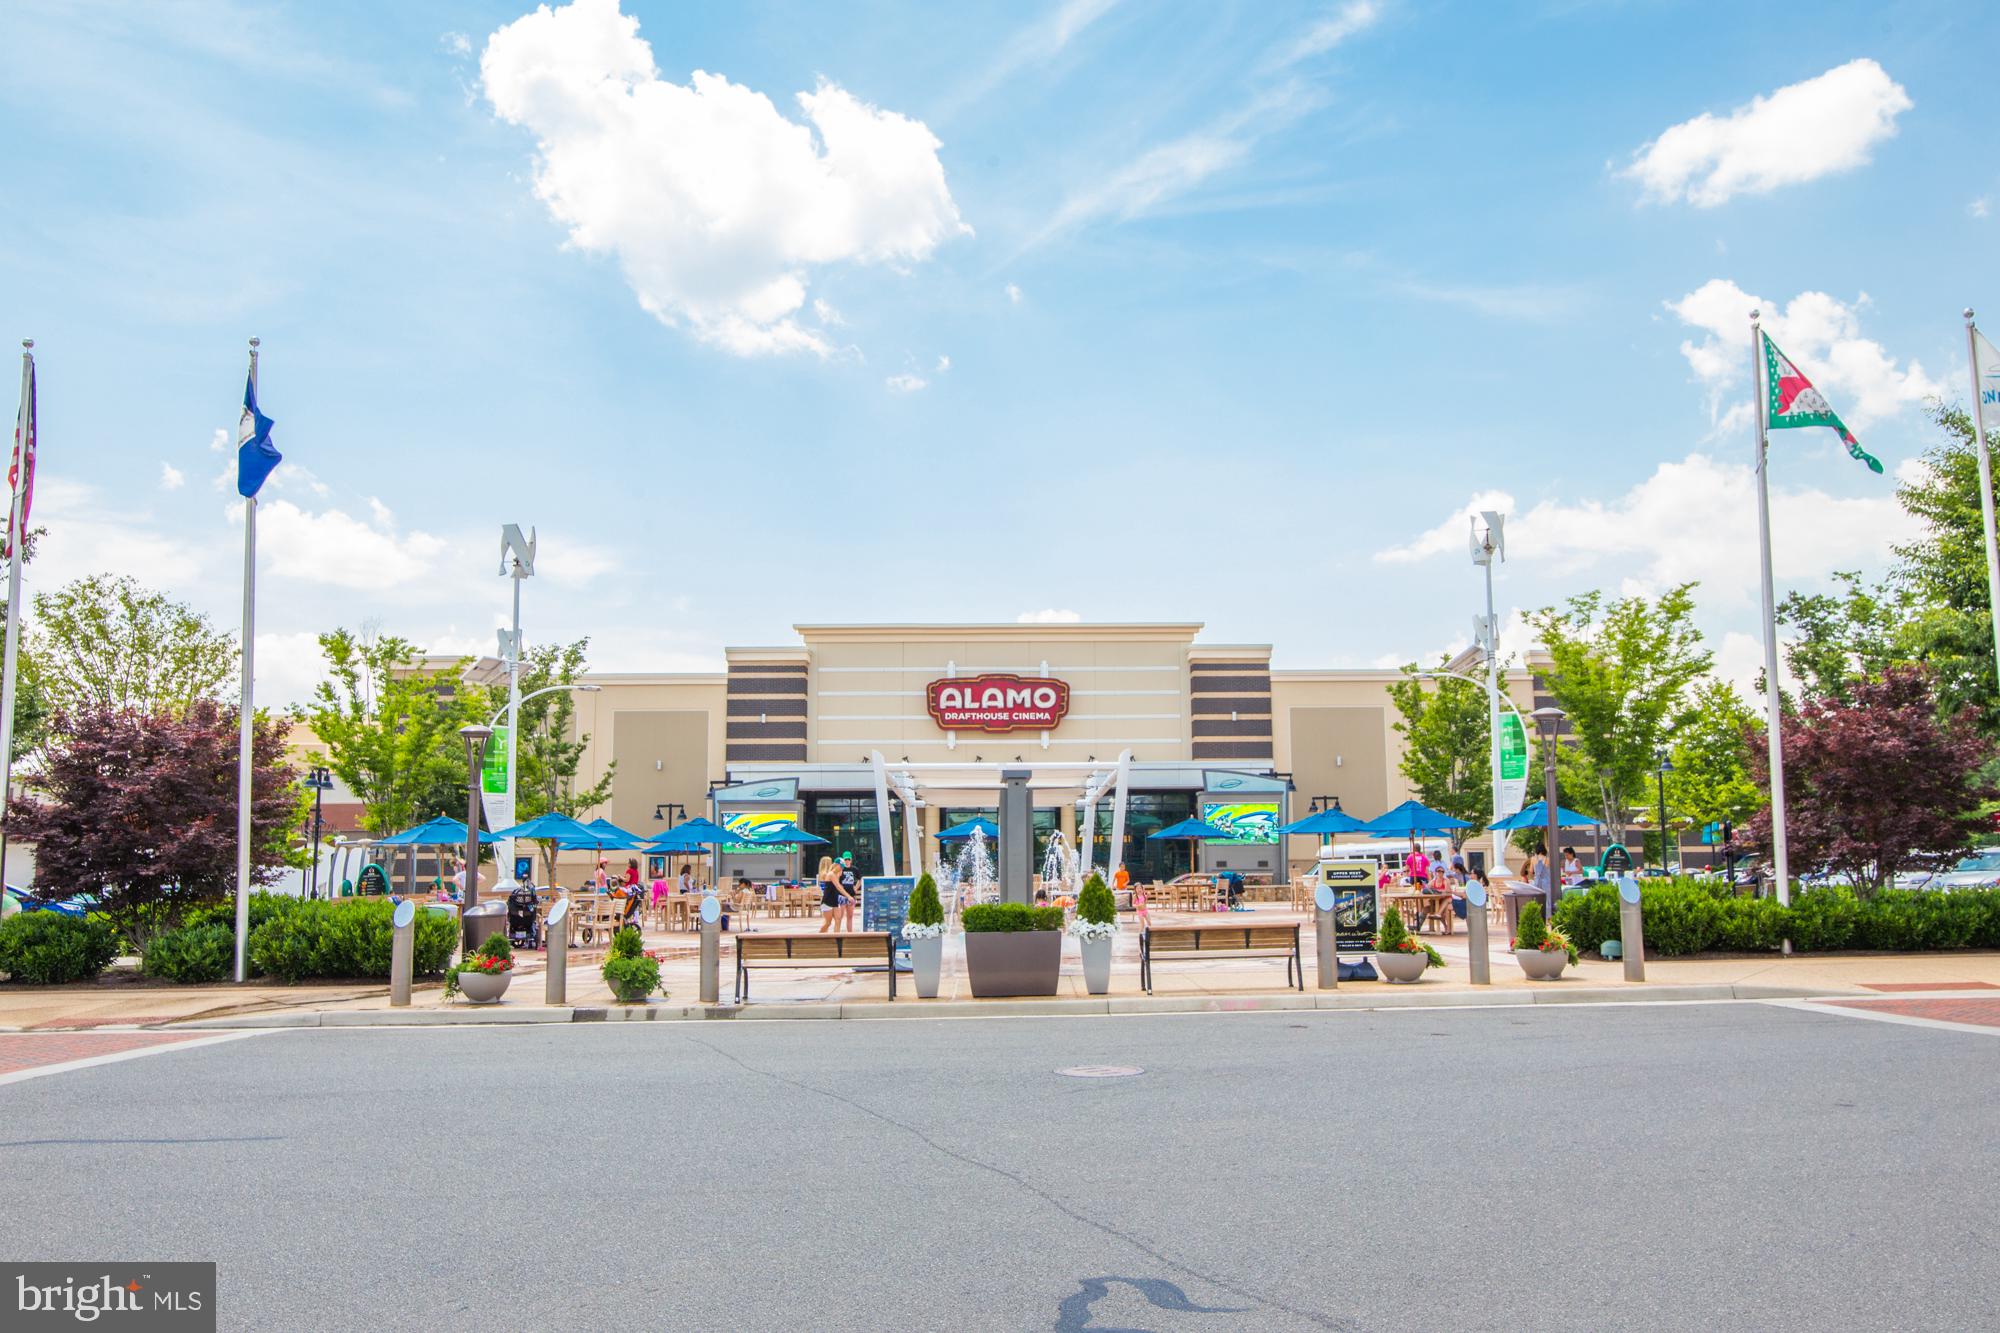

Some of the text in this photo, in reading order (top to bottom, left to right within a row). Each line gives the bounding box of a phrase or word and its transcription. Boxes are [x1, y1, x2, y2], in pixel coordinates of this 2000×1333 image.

[940, 687, 1057, 709] ALAMO
[945, 712, 1051, 720] DRAFTHOUSE CINEMA
